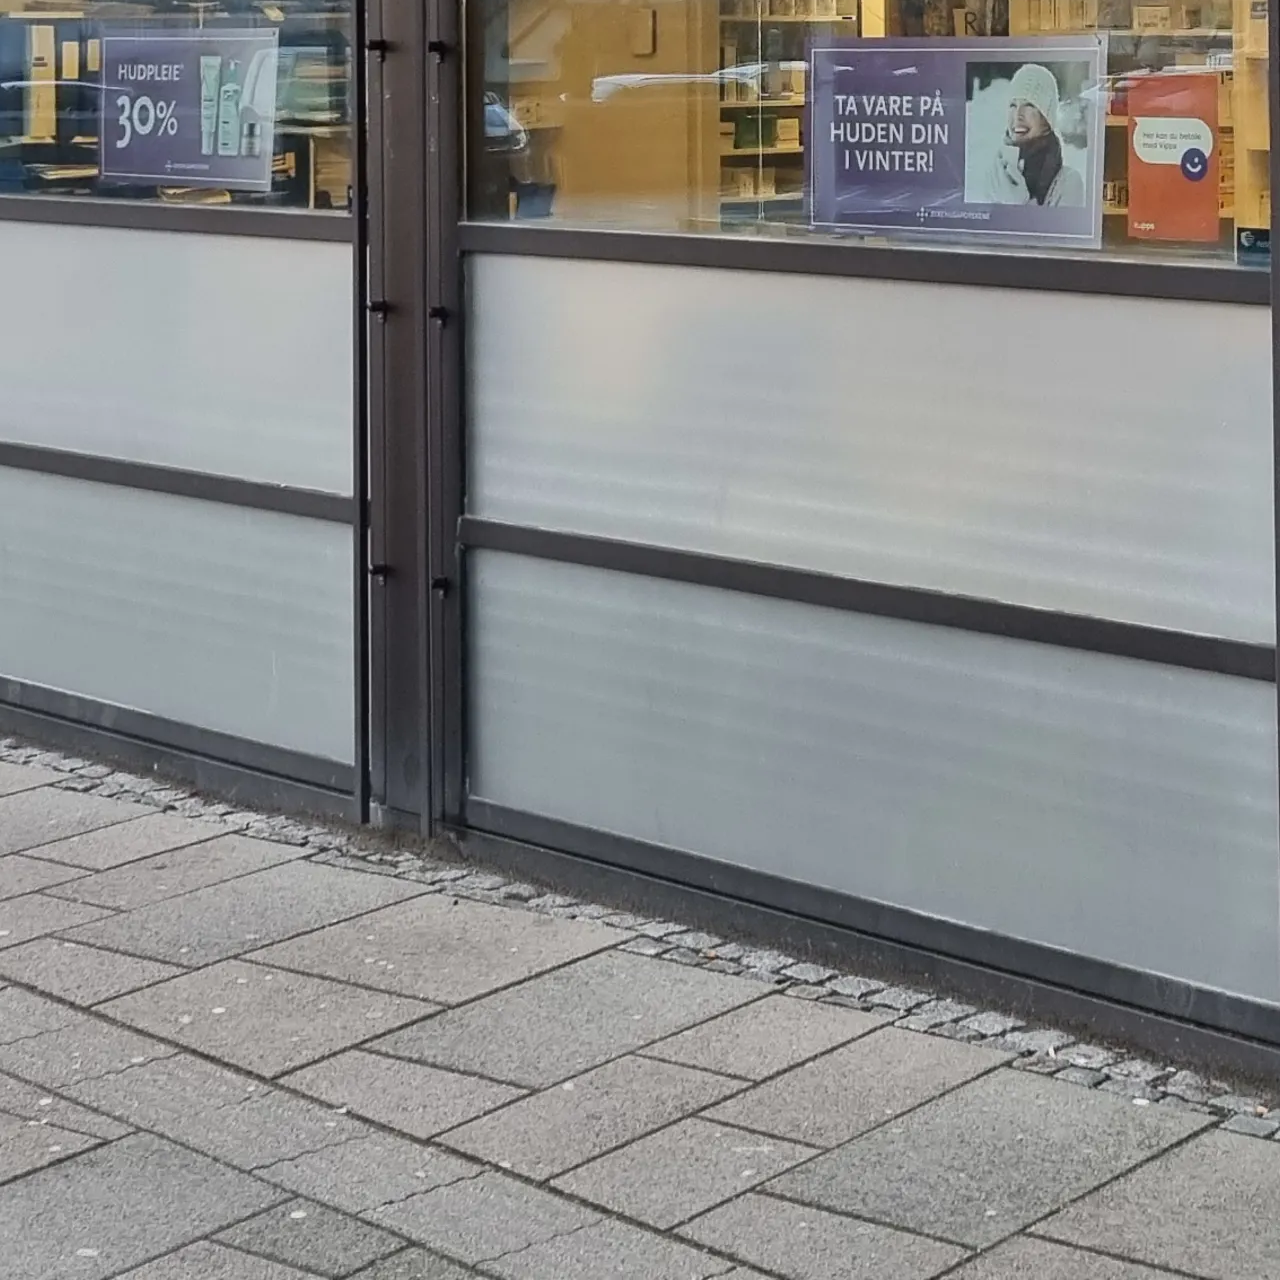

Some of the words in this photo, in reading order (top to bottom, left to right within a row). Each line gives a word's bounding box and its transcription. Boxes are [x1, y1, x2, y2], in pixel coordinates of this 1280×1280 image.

[834, 95, 858, 116] TA
[862, 95, 913, 116] VARE
[920, 89, 944, 116] PÅ
[116, 95, 178, 149] 30%
[830, 121, 904, 144] HUDEN
[911, 123, 949, 145] DIN
[845, 149, 850, 170] I
[855, 149, 933, 173] VINTER!
